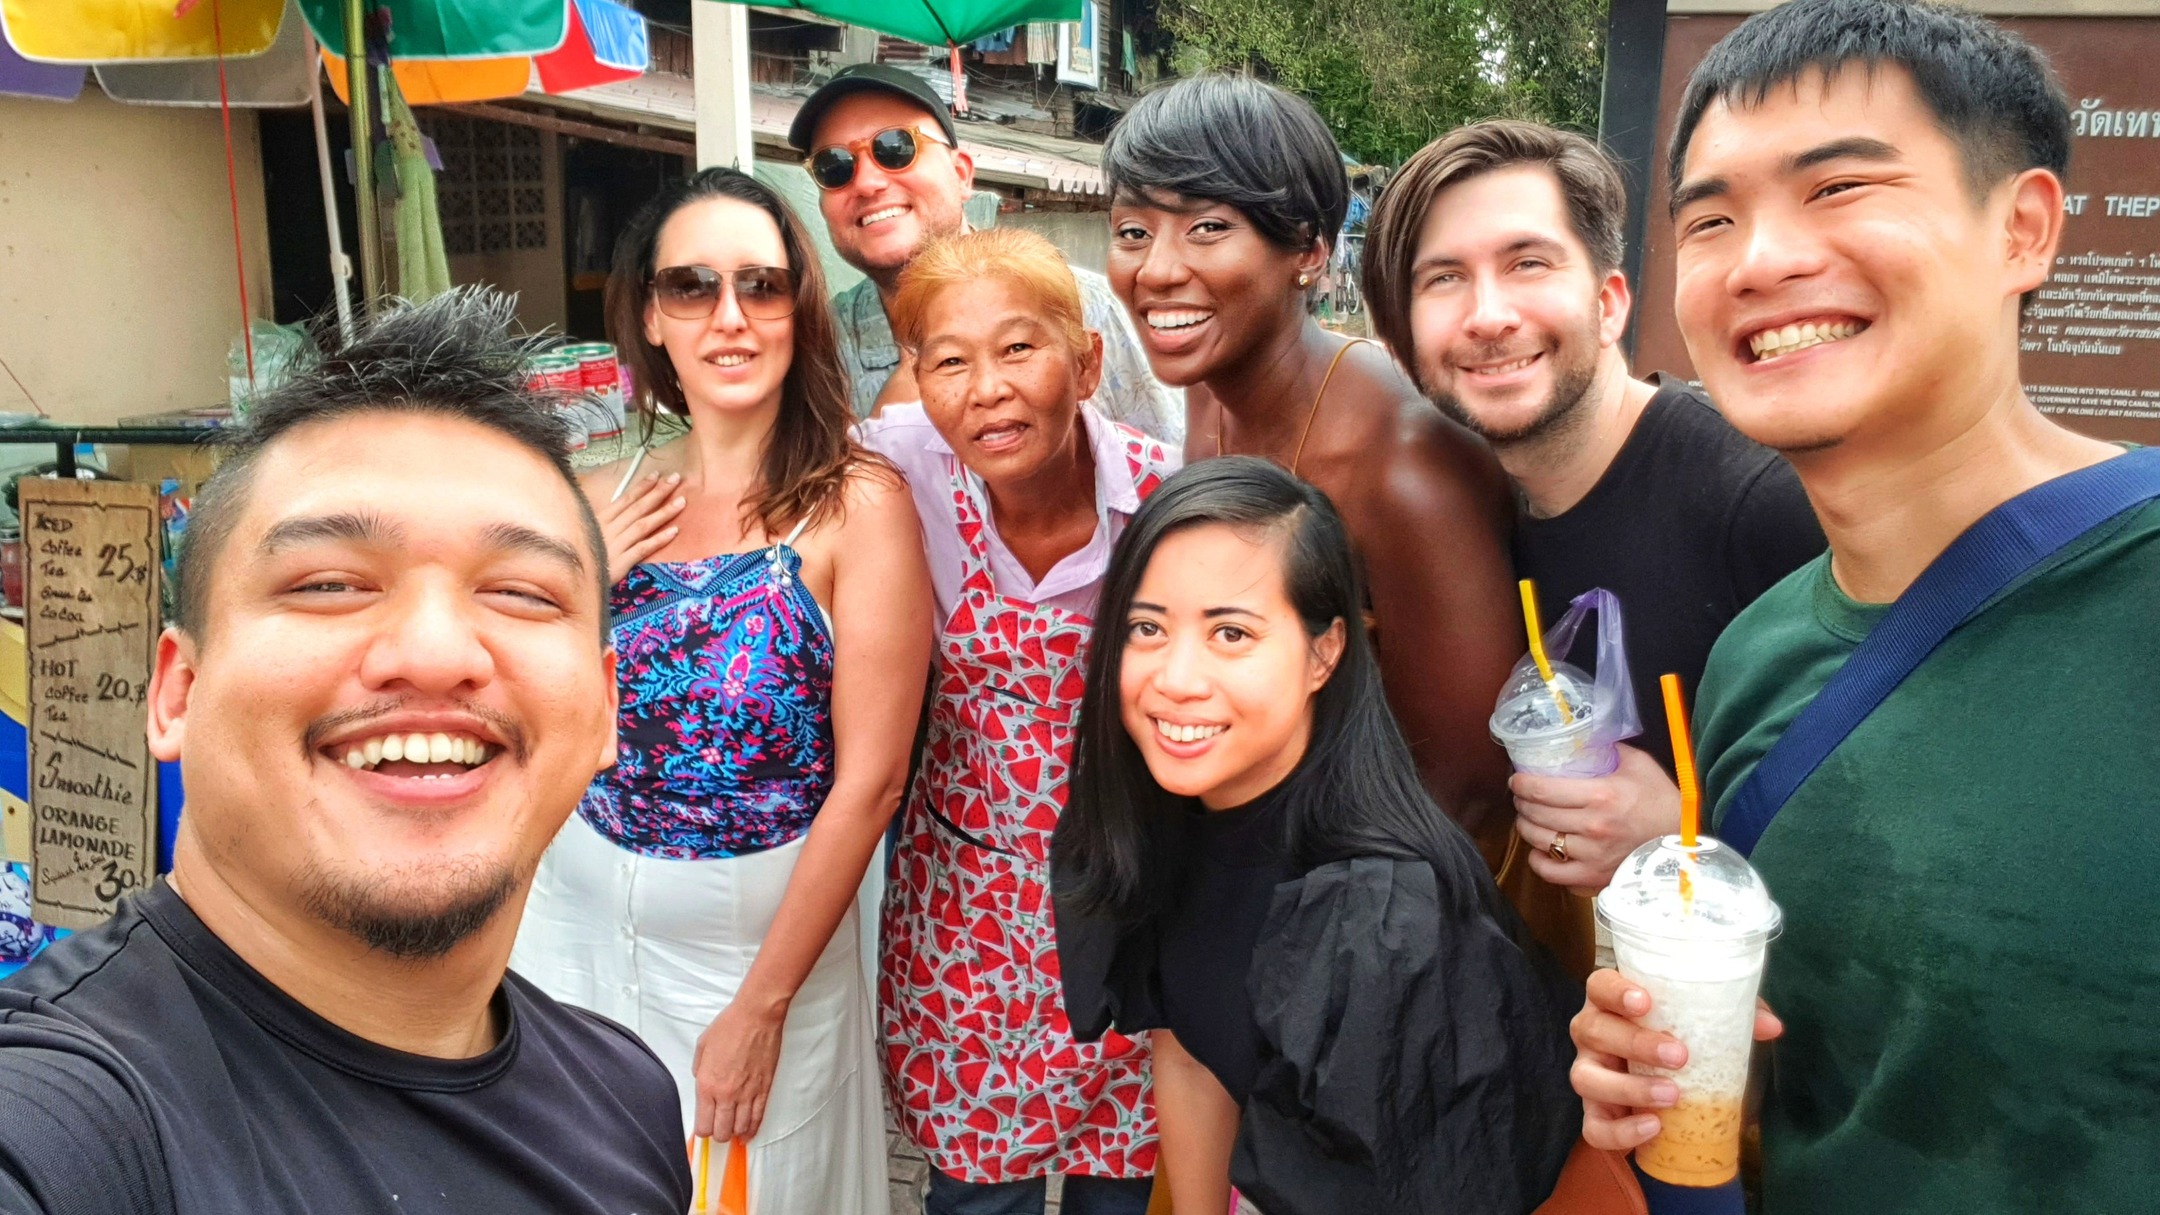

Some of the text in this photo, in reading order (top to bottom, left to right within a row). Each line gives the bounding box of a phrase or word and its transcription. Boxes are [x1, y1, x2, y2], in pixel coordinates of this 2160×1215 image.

[2104, 195, 2160, 217] THEP
[2036, 396, 2080, 405] GOVERNMENT
[2038, 385, 2078, 395] SEPARATING
[39, 750, 133, 805] Smoothie
[41, 805, 120, 835] ORANGE
[40, 827, 136, 861] LAMONADE
